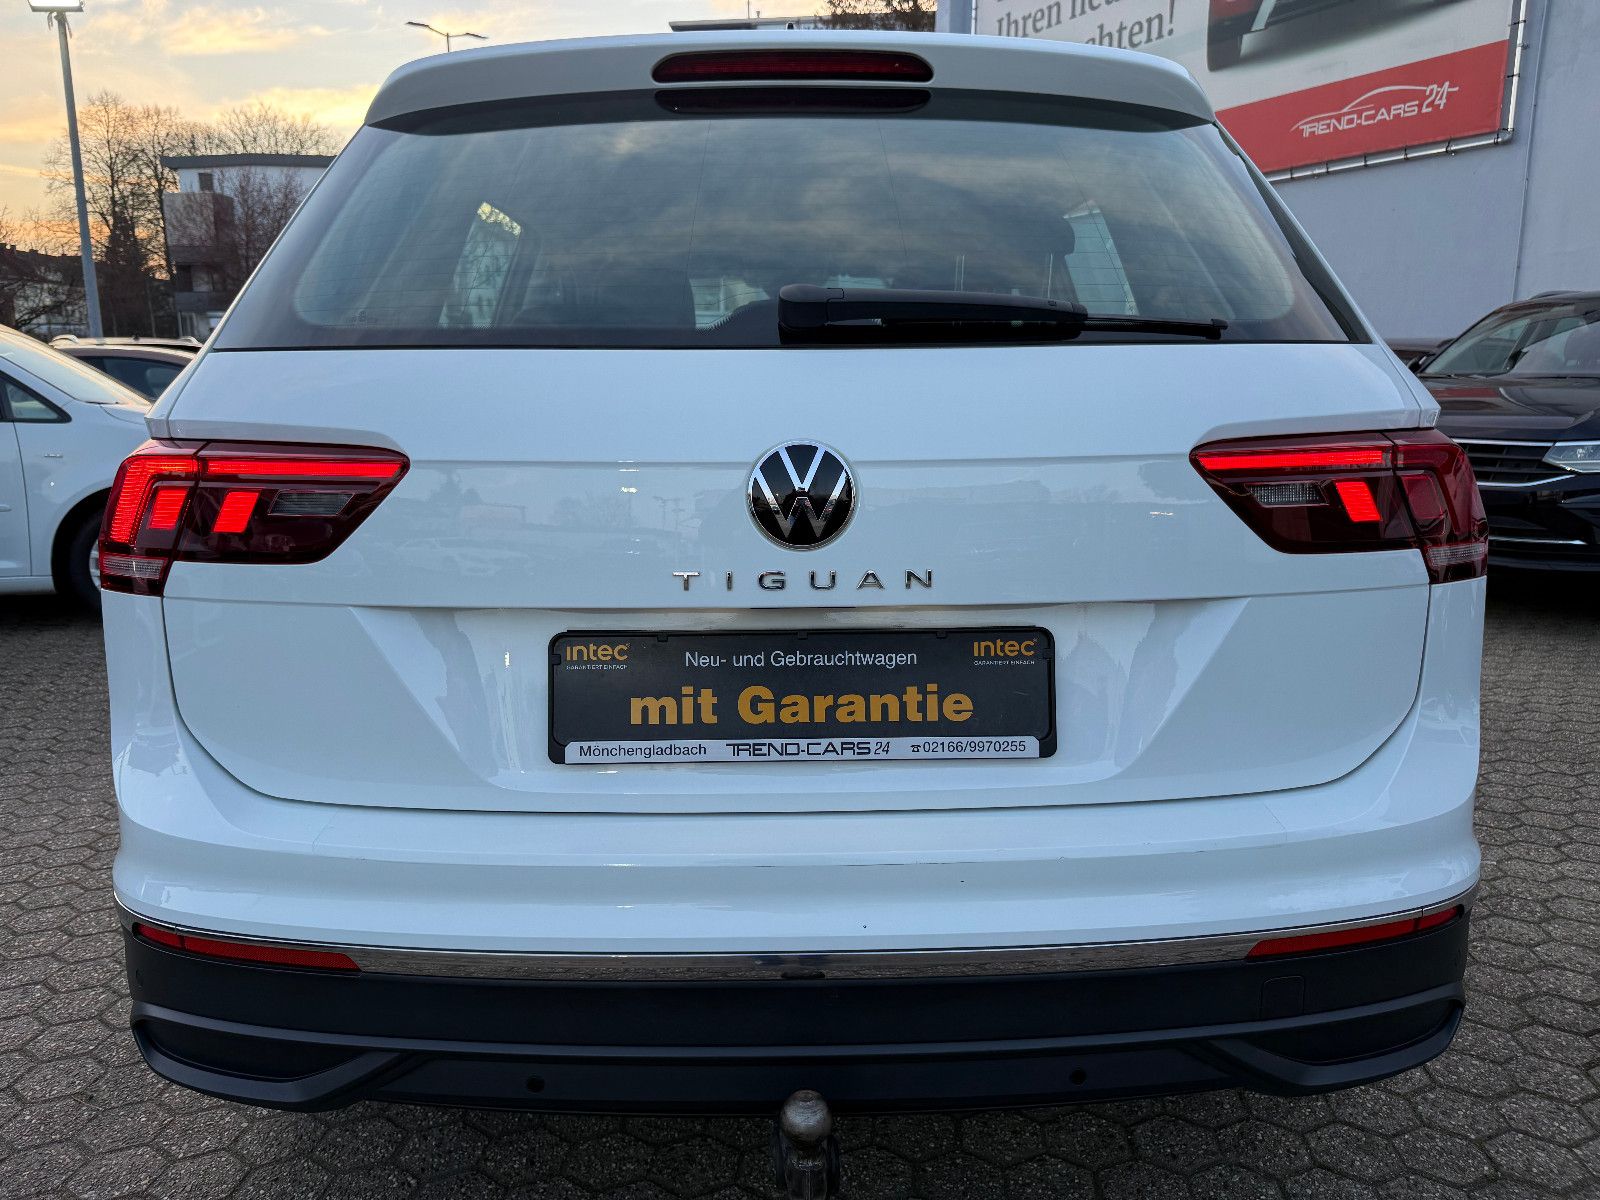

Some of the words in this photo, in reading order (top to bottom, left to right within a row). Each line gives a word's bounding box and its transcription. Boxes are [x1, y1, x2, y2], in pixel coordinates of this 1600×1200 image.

[996, 0, 1062, 37] Ihren
[1299, 100, 1419, 138] TREND-CARS
[672, 568, 933, 592] TIGUAN
[566, 643, 628, 661] intec
[973, 638, 1035, 657] intec
[685, 651, 727, 668] Neu-
[733, 651, 765, 667] und
[770, 649, 918, 669] Gebrauchtwagen
[630, 685, 718, 725] mit
[737, 683, 975, 726] Garantie
[579, 743, 708, 759] Mönchengladbach
[726, 741, 871, 757] TREND-CARS
[873, 740, 891, 756] 24
[922, 740, 1027, 754] 02166/9970255
